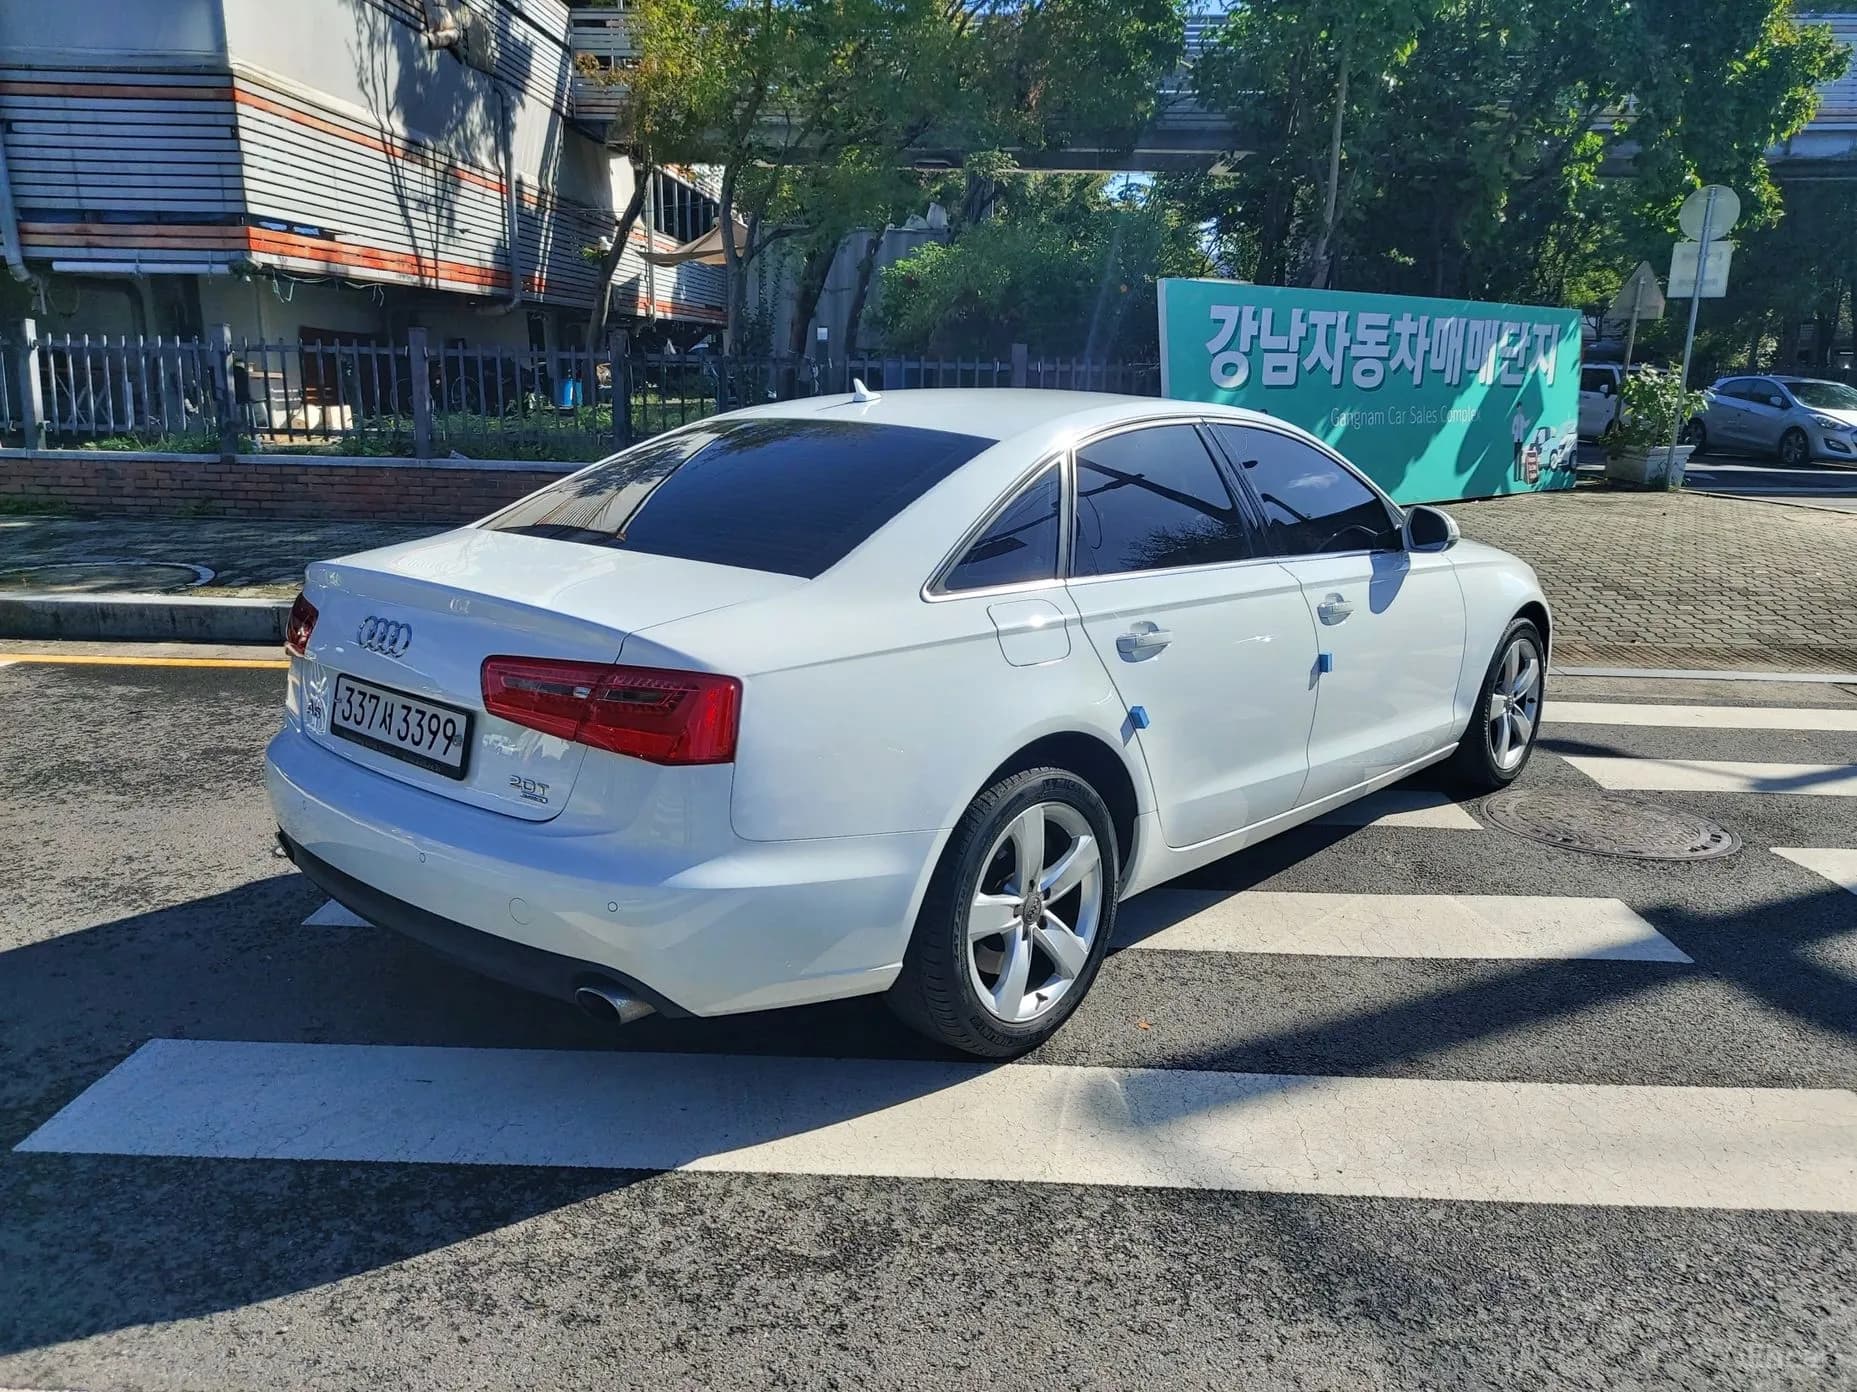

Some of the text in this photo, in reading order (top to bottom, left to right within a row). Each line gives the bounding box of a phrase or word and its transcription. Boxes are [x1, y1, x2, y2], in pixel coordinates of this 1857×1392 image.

[1206, 304, 1561, 390] 강남자동차매매단지
[1330, 405, 1480, 430] Gangnam Car Sales Complex
